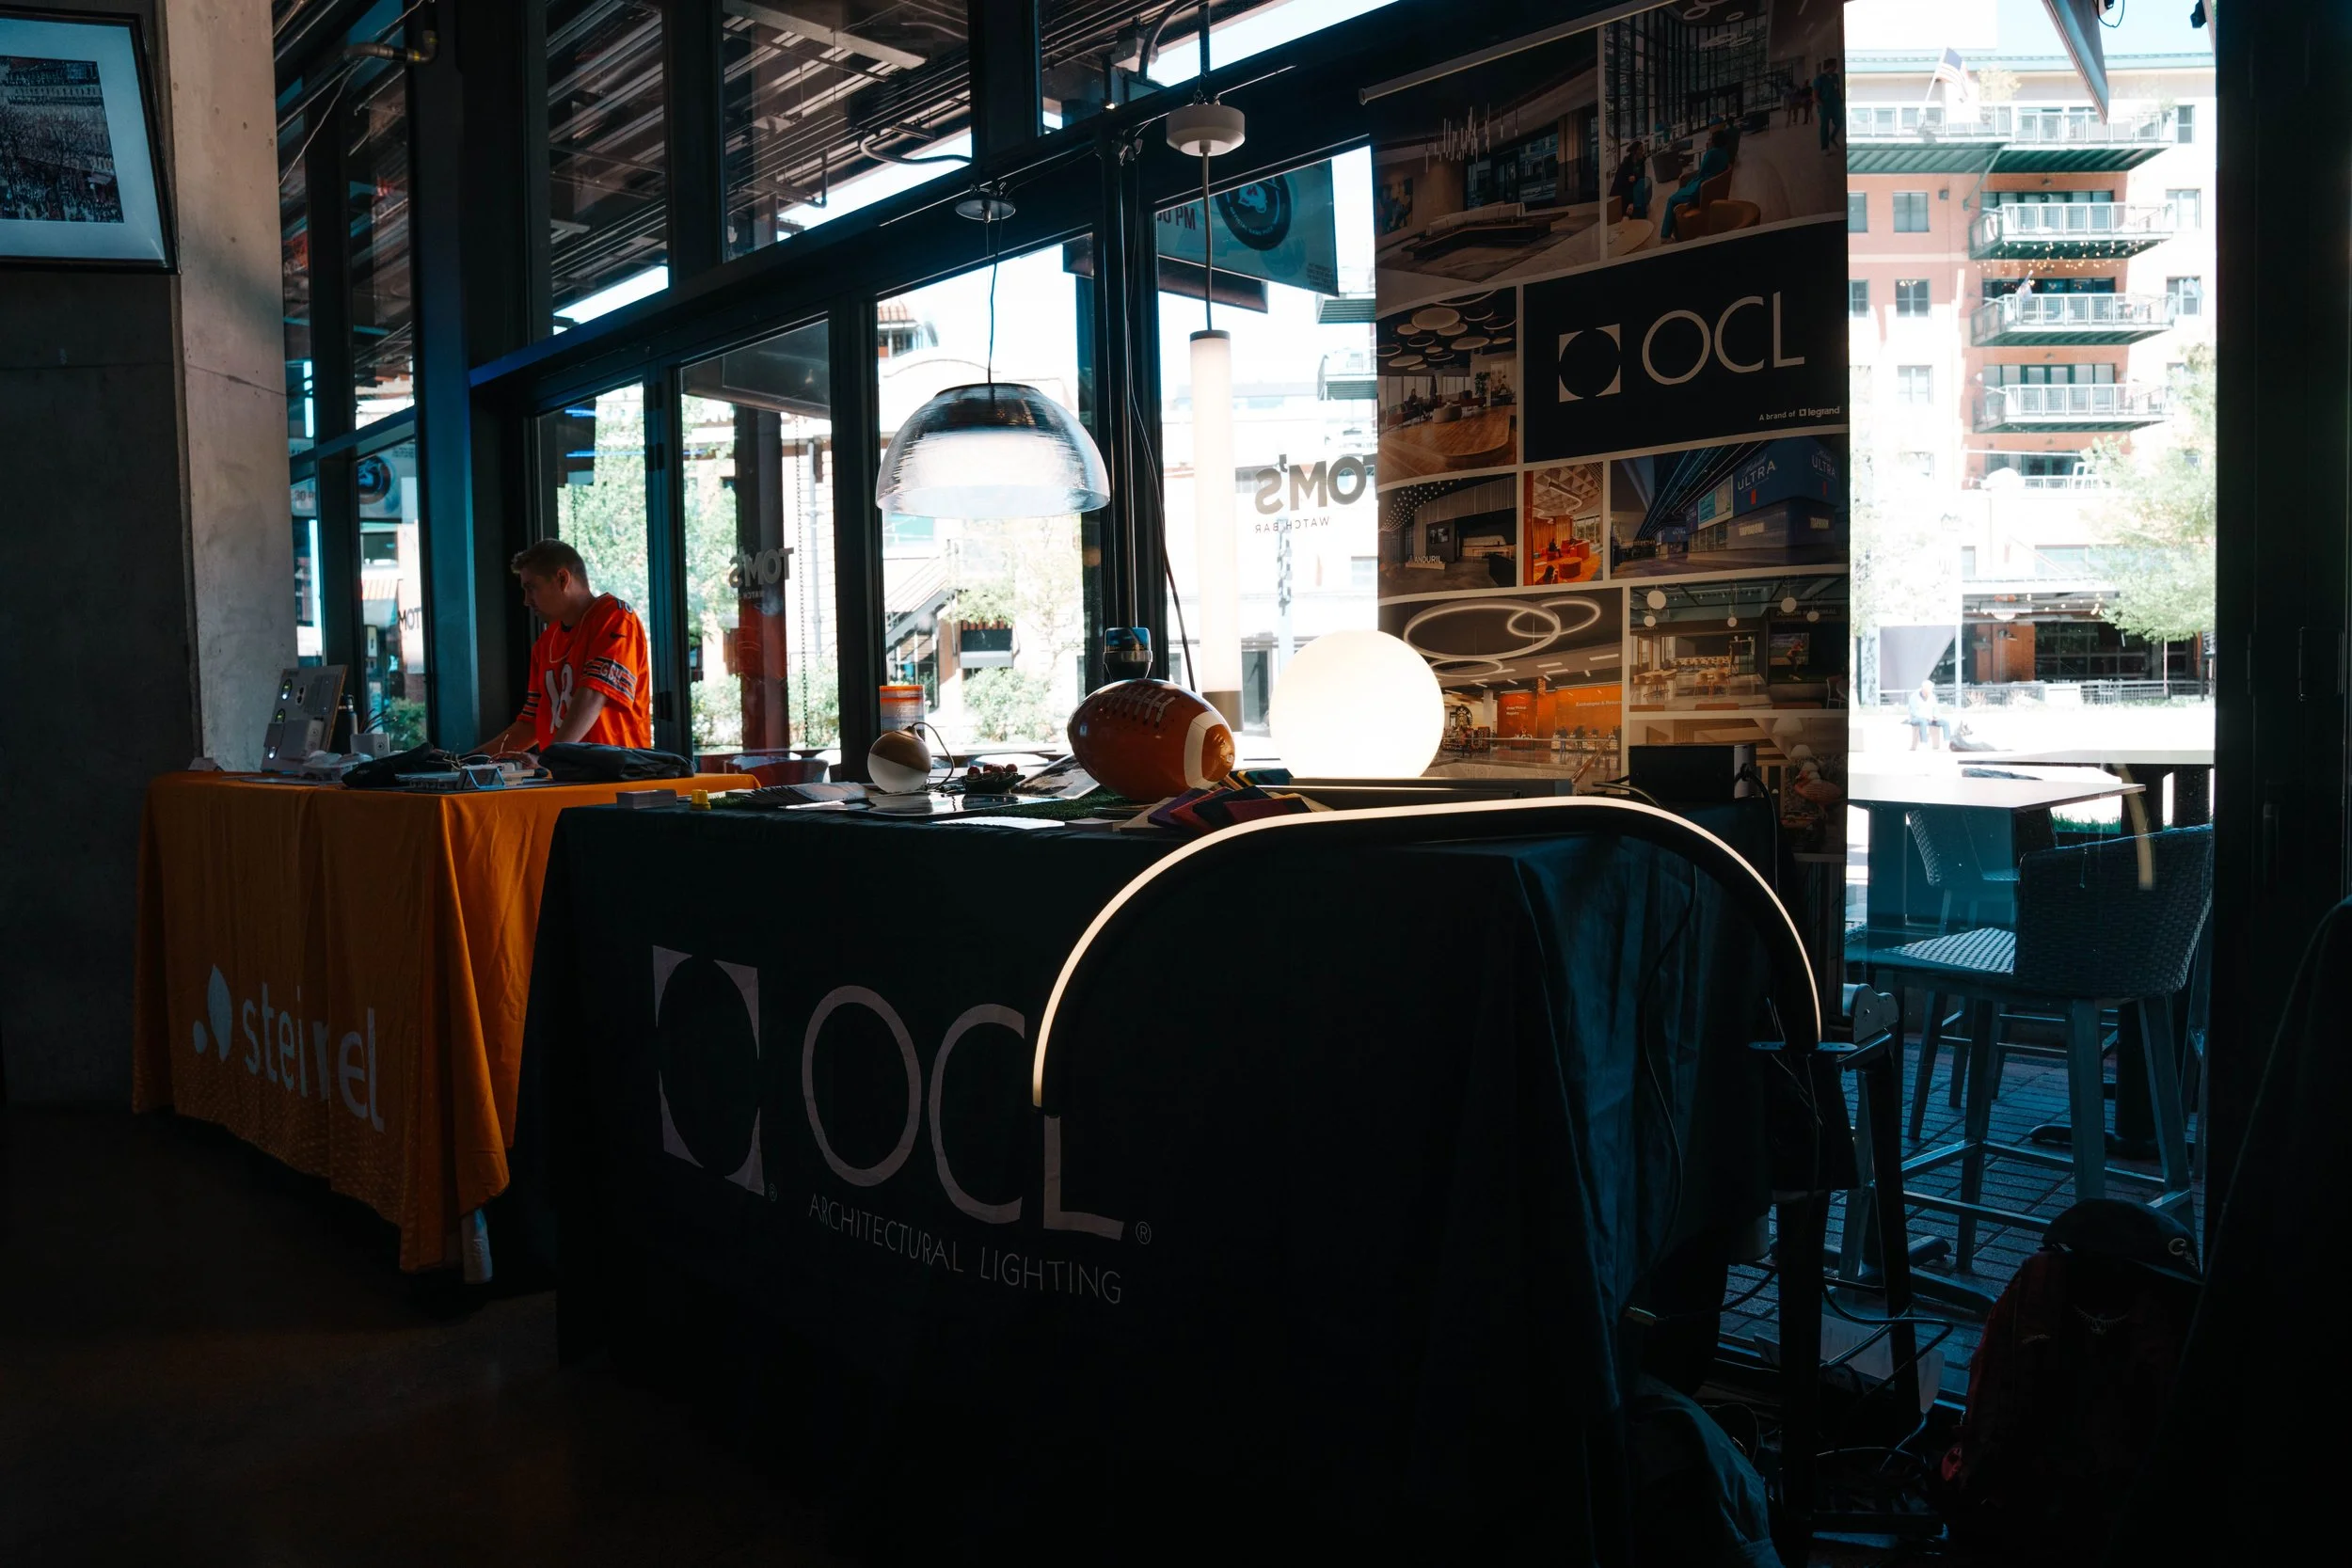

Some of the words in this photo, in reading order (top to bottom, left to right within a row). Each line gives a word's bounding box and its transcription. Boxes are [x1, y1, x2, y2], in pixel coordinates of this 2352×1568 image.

[1175, 206, 1196, 230] PM
[1641, 290, 1805, 387] OCL
[1758, 413, 1765, 422] A
[1766, 411, 1788, 421] brand
[1788, 409, 1796, 419] of
[1807, 405, 1840, 419] legrand
[1737, 459, 1777, 491] ULTRA
[1811, 454, 1836, 479] ULTRA
[545, 662, 574, 735] 18
[801, 984, 1125, 1242] OCL
[807, 1193, 964, 1274] ARCHITECTURAL
[979, 1244, 1122, 1305] LIGHTING
